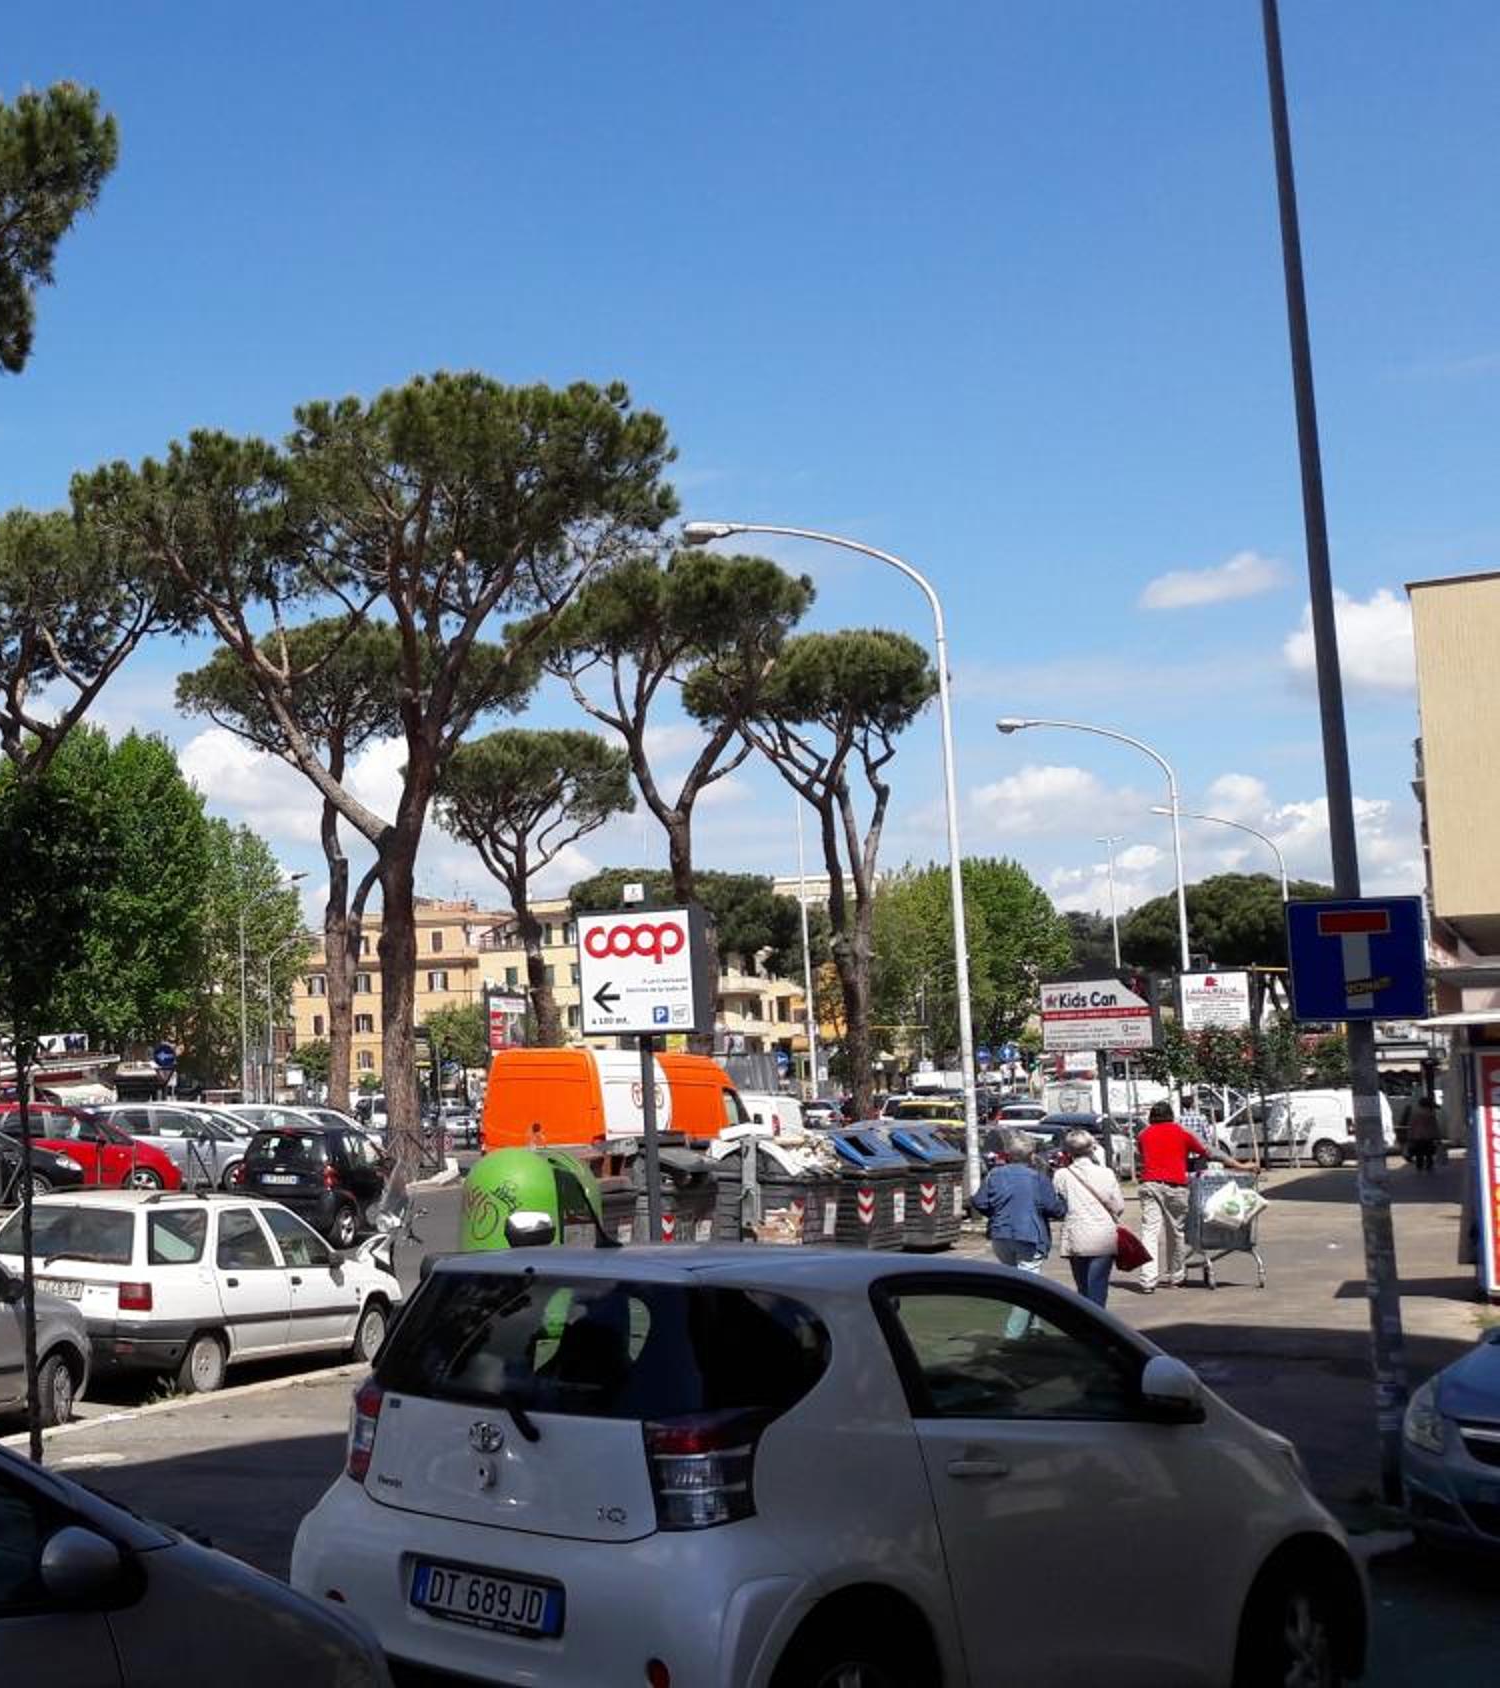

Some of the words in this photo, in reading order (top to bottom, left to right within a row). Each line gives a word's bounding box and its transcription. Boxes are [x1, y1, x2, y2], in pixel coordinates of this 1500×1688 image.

[584, 922, 685, 965] coop
[1059, 992, 1088, 1008] Kids
[1090, 991, 1117, 1007] Can
[430, 1570, 460, 1605] DT
[467, 1579, 543, 1624] 689JD
